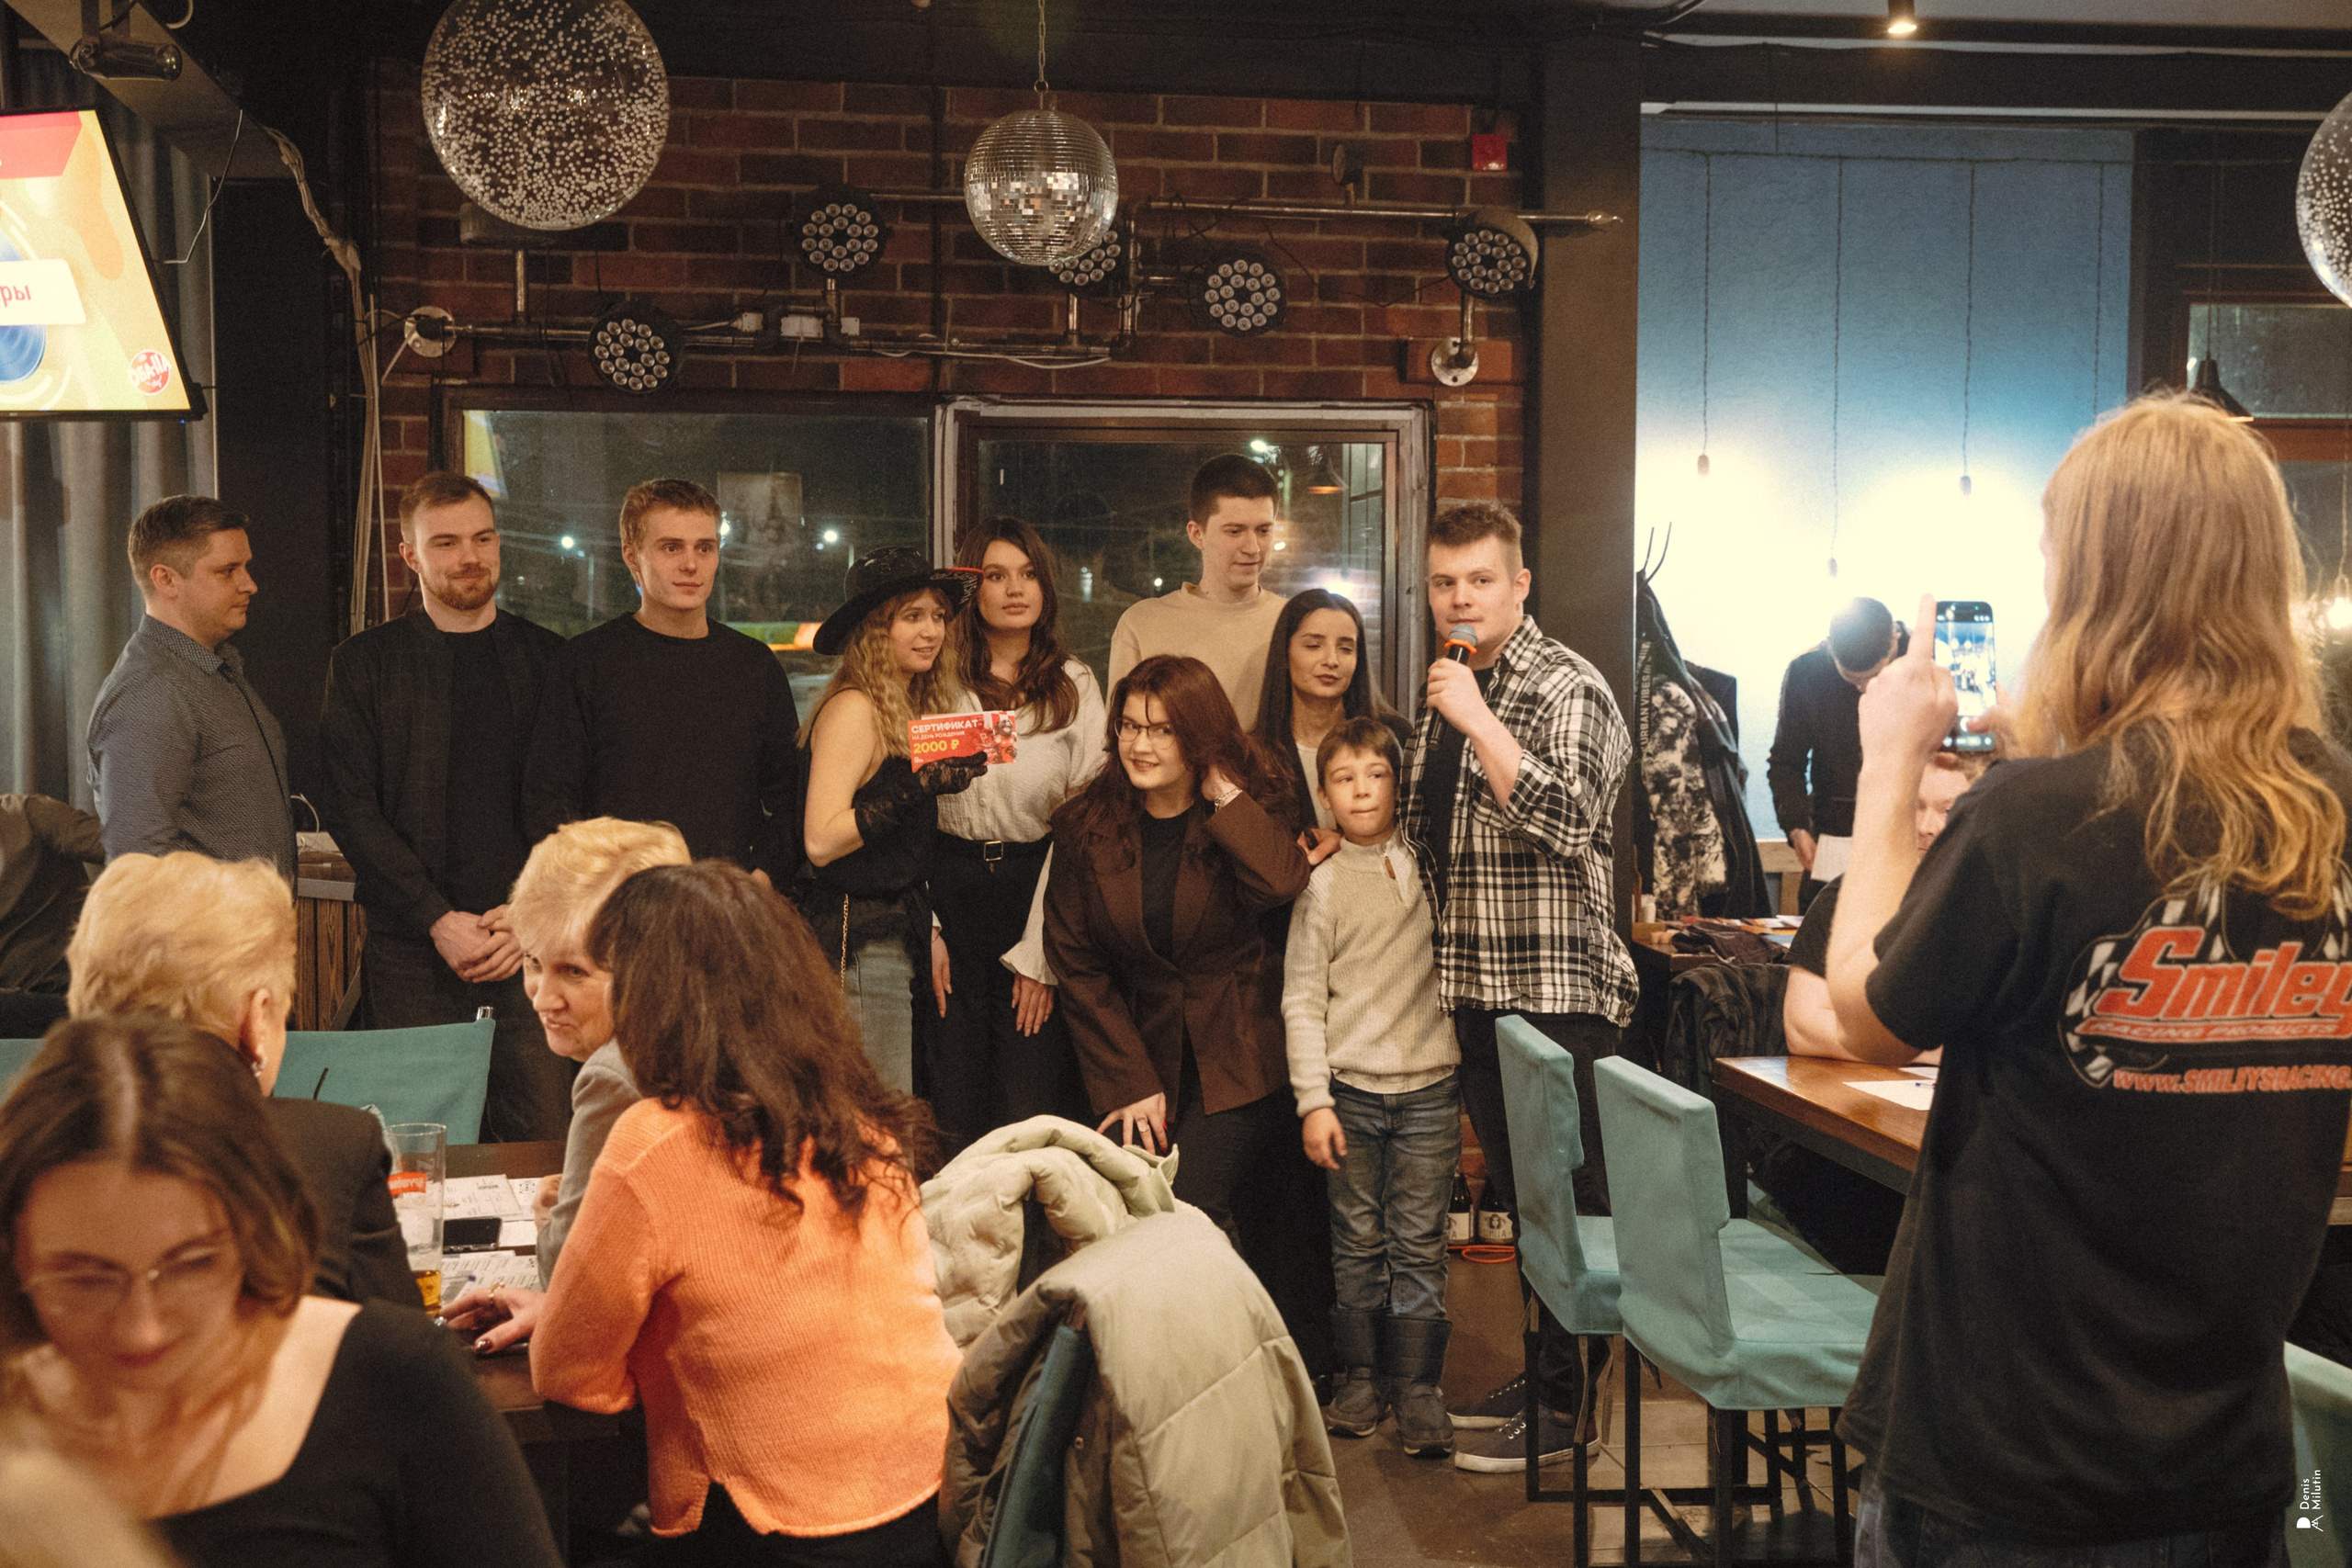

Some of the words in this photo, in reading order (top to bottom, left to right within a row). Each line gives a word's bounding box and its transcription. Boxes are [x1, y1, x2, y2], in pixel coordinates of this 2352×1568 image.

[1641, 674, 1651, 706] VIBES
[911, 720, 978, 733] СЕРТИФИКАТ
[1640, 707, 1650, 746] URBAN
[935, 730, 965, 739] РОЖДЕНИЯ
[913, 740, 947, 753] 2000
